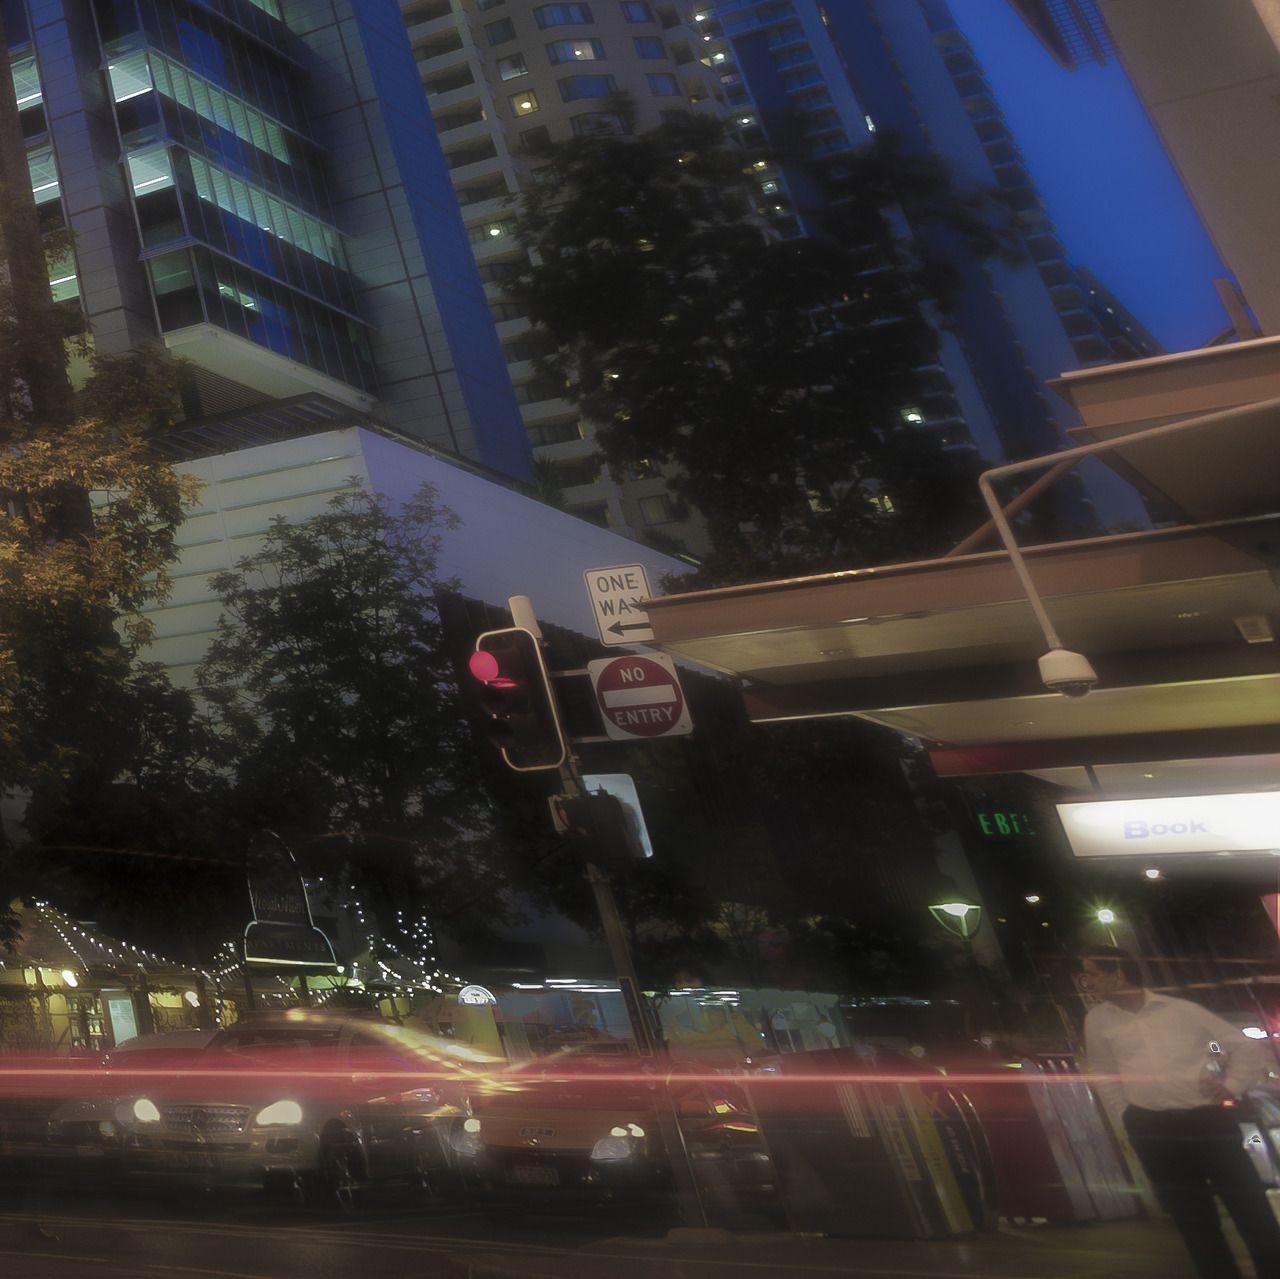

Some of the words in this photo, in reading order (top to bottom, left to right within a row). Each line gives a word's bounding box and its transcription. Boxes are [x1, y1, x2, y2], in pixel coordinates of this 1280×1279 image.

[596, 573, 639, 593] ONE
[620, 666, 646, 684] NO
[614, 706, 674, 727] ENTRY
[1123, 818, 1208, 840] Book
